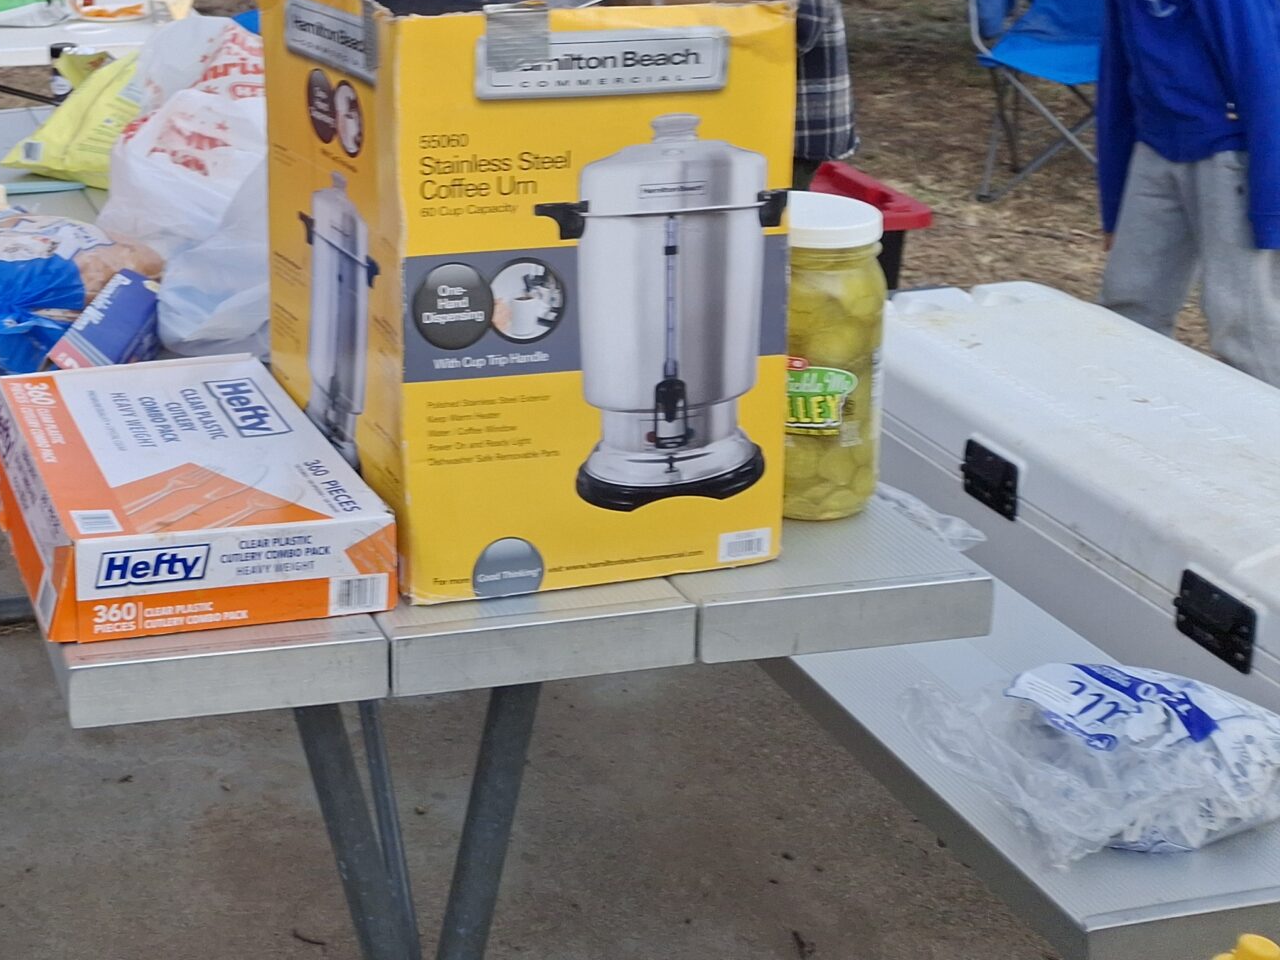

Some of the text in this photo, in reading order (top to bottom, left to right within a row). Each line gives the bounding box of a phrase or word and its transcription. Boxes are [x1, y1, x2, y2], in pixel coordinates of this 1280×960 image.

[518, 48, 701, 72] amilton Beach
[518, 75, 686, 88] COMMERCIAL
[419, 133, 469, 149] 55060
[419, 150, 572, 176] Stainless Steel
[420, 175, 538, 200] Coffee Urn
[440, 205, 464, 217] Cup
[468, 203, 518, 216] Capacity
[437, 297, 469, 310] Hand
[422, 309, 485, 325] Dispensing
[433, 350, 550, 370] With Cup Trip Handle
[24, 382, 57, 407] 360
[165, 401, 199, 432] CUTLERY
[180, 388, 229, 440] CLEAR PLASTIC
[216, 382, 274, 433] Hefty
[111, 392, 157, 448] HEAVY WEIGHT
[138, 396, 182, 443] COMBO PACK
[303, 460, 330, 477] 360
[320, 480, 362, 512] PIECES
[239, 535, 312, 550] CLEAR PLASTIC
[220, 545, 331, 563] CUTLERY COMBO PACK
[104, 553, 200, 581] Hefty
[236, 560, 315, 575] HEAVY WEIGHT
[477, 573, 501, 583] Good
[92, 602, 137, 624] 360
[143, 602, 214, 617] CLEAR PLASTIC
[143, 610, 249, 629] CUTLERY COMBO PACK
[93, 622, 137, 634] PIECES
